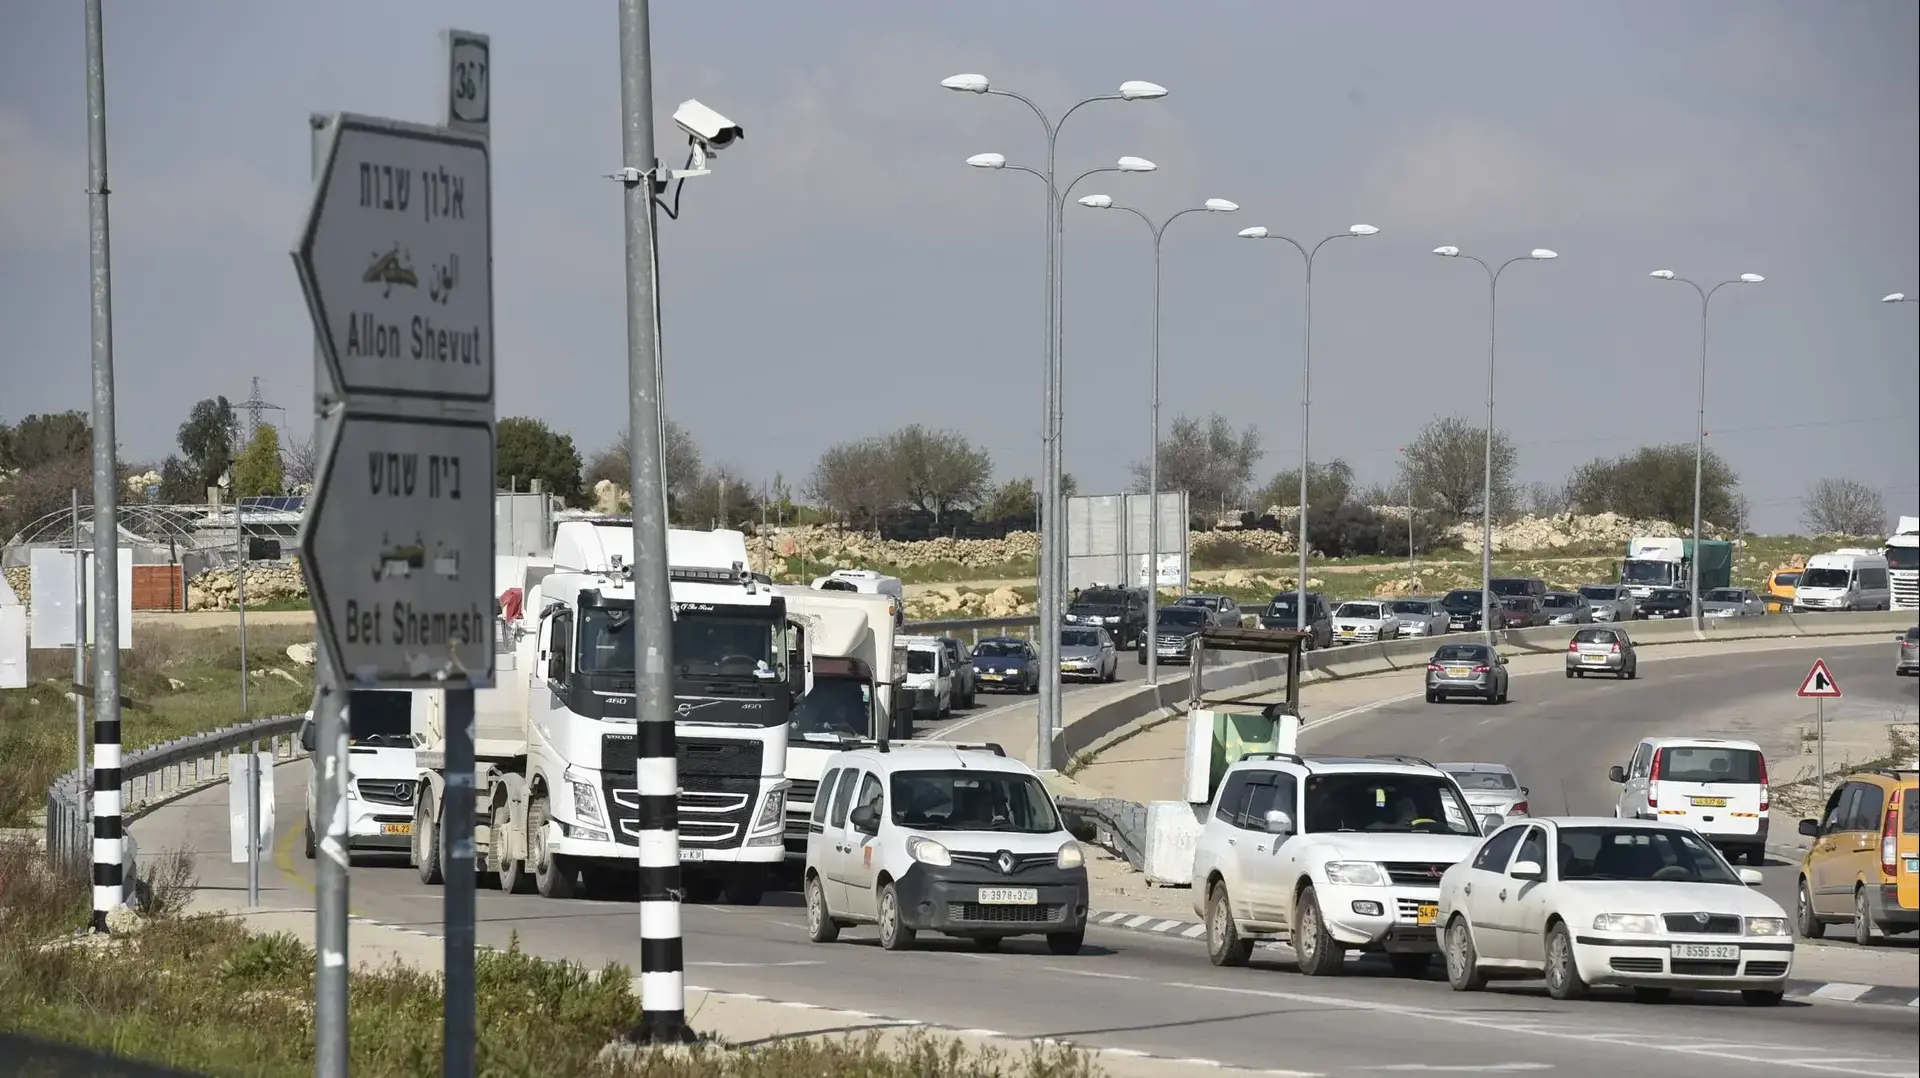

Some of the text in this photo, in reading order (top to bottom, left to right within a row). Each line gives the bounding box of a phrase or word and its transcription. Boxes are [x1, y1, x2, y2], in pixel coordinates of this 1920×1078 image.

[360, 161, 465, 224] אלון שבות
[347, 311, 481, 366] Allon Shevut
[368, 451, 461, 500] בית שמש
[346, 599, 483, 646] Bet Shemesh
[605, 697, 627, 705] 460
